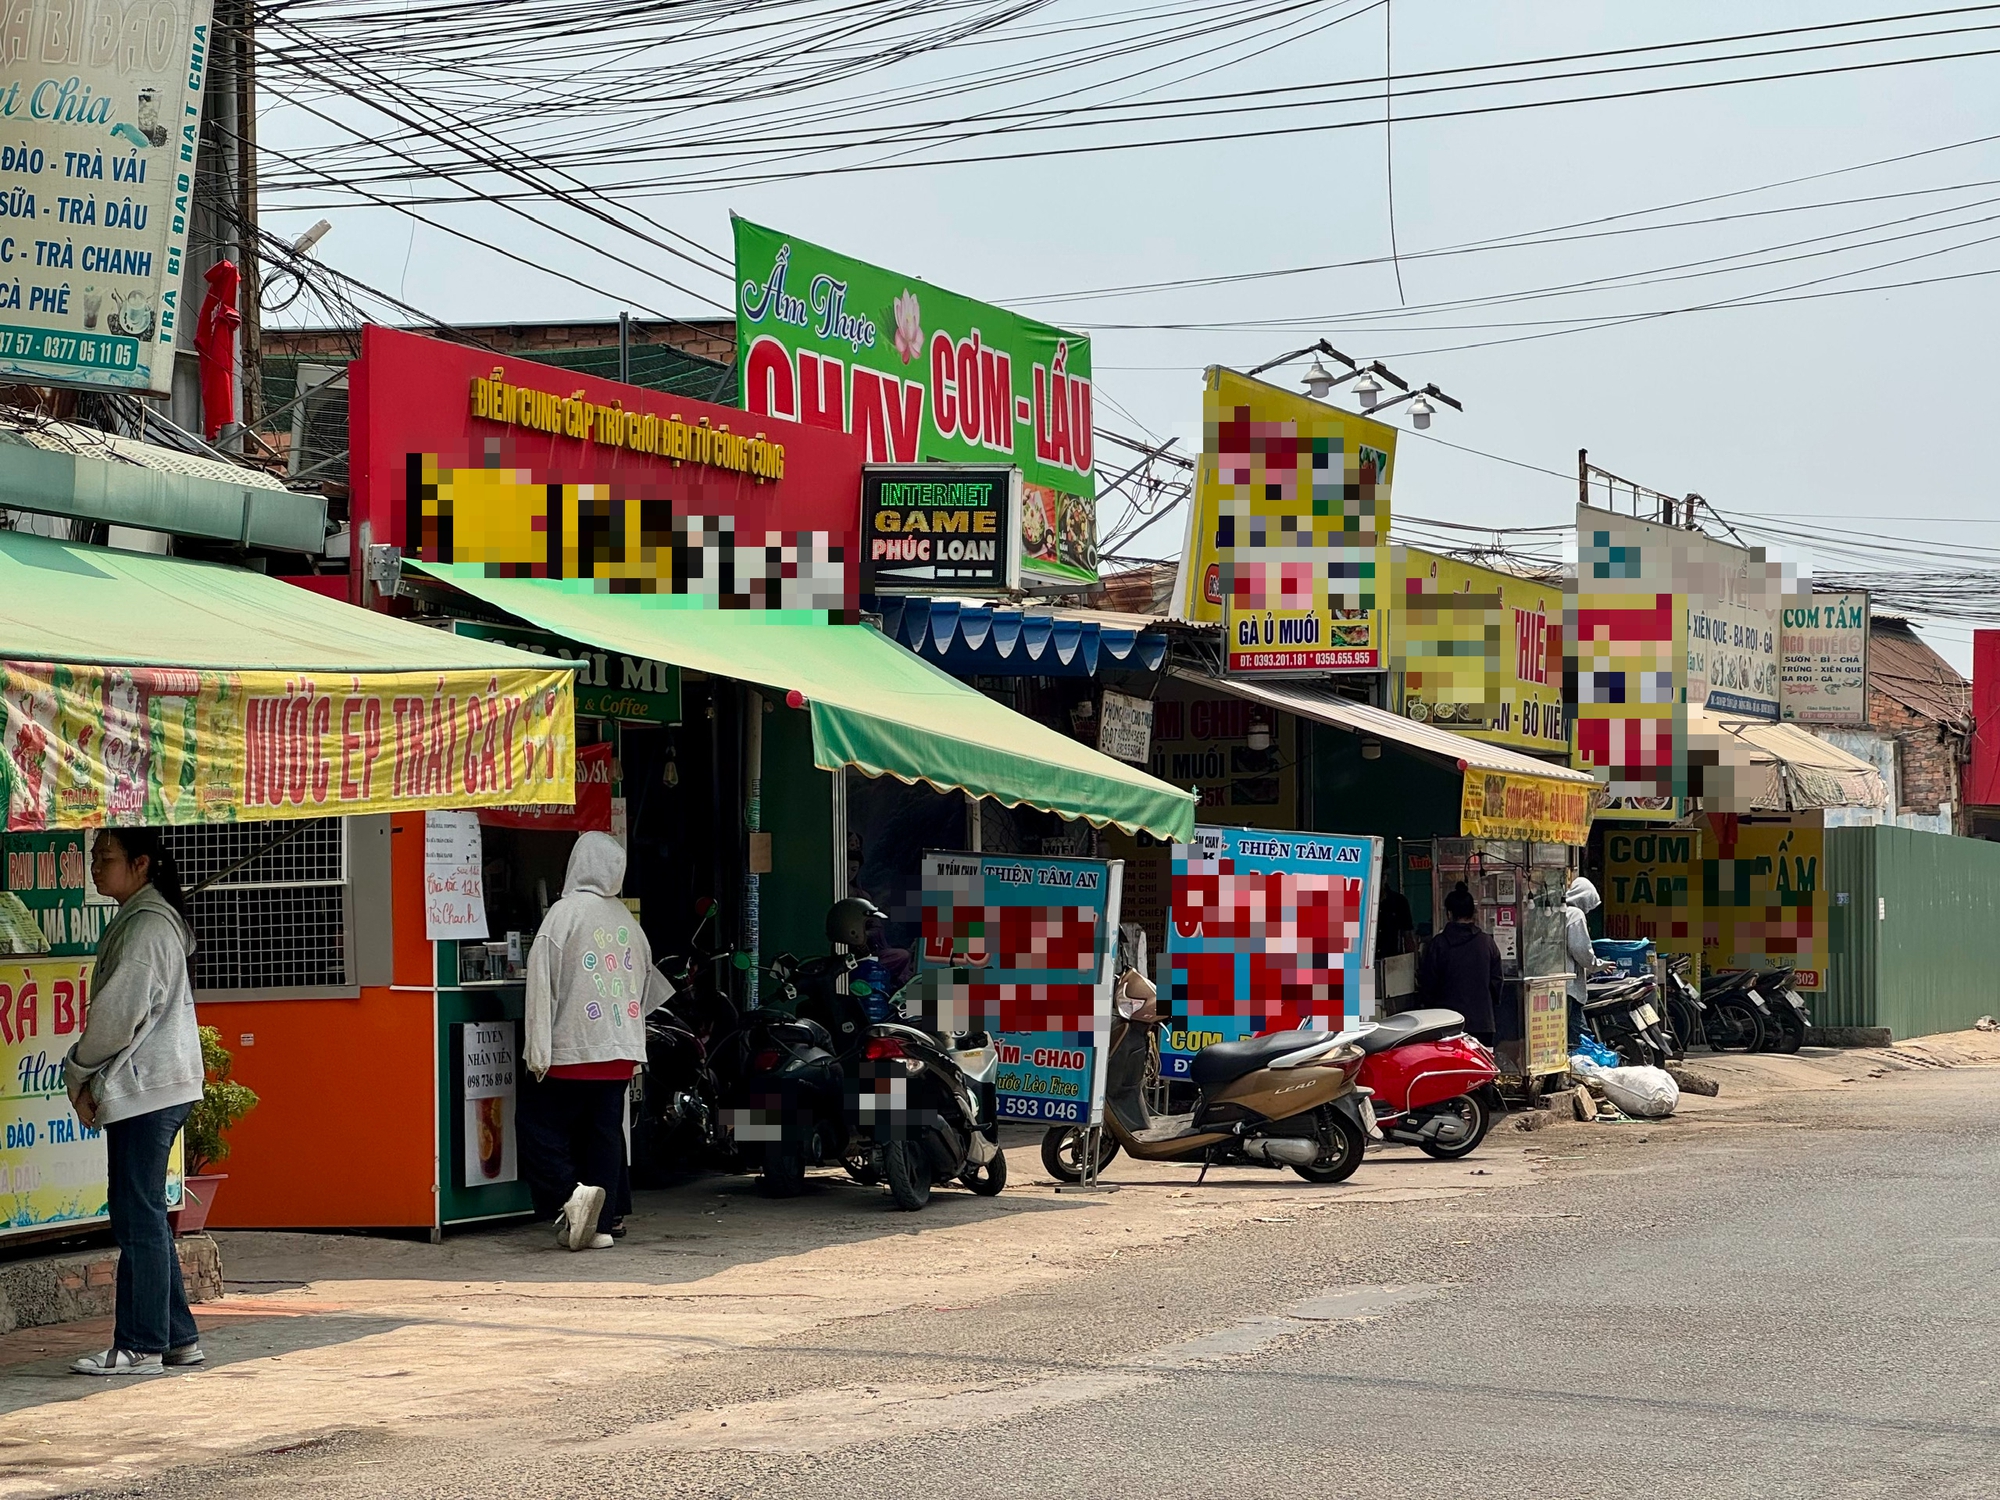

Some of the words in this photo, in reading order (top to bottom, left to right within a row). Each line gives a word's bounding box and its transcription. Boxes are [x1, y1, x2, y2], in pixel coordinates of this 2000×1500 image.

[188, 24, 207, 92] CHIA
[31, 75, 115, 124] Chia
[180, 101, 200, 163] HẠT
[1, 140, 44, 174] ĐÀO
[64, 147, 103, 179] TRÀ
[112, 147, 147, 184] VẢI
[0, 186, 36, 220] SỮA
[57, 193, 96, 226] TRÀ
[104, 196, 148, 230] DÂU
[171, 173, 190, 234] ĐAO
[35, 237, 73, 269] TRÀ
[82, 246, 152, 276] CHANH
[167, 246, 182, 276] BÍ
[29, 283, 71, 315] PHÊ
[743, 244, 807, 322] Ẩm
[810, 273, 876, 352] Thực
[159, 289, 178, 344] TRÀ
[16, 333, 33, 357] 57
[43, 336, 75, 364] 0377
[79, 340, 96, 364] 05
[99, 343, 112, 364] 11
[115, 345, 132, 366] 05
[472, 366, 517, 424] ĐIỂM
[516, 387, 562, 434] CUNG
[561, 389, 594, 440] CẤP
[594, 399, 625, 447] TRÒ
[623, 411, 660, 456] CHƠI
[659, 413, 693, 468] ĐIỆN
[691, 416, 712, 465] TỬ
[711, 424, 748, 472] CÔNG
[747, 432, 785, 485] CỘNG
[880, 483, 993, 507] INTERNET
[874, 510, 997, 533] GAME
[871, 534, 931, 561] PHÚC
[936, 539, 996, 561] LOAN
[1239, 616, 1259, 646] GÀ
[1264, 611, 1274, 645] Ủ
[1279, 610, 1320, 644] MUỐI
[1824, 595, 1863, 629] TẤM
[1693, 610, 1711, 640] XIÊN
[1712, 618, 1727, 646] QUE
[1733, 624, 1744, 648] BA
[1745, 627, 1758, 655] RỌI
[1763, 626, 1773, 654] GÀ
[1240, 656, 1252, 667] ĐT:
[1254, 652, 1307, 667] 0393.201.181
[1315, 651, 1370, 665] 0359.655.955
[1782, 665, 1812, 673] TRỨNG
[1820, 665, 1842, 673] XIÊN
[1844, 666, 1863, 674] QUE
[1784, 655, 1811, 663] SƯỜN
[1820, 654, 1830, 663] BÌ
[1839, 655, 1859, 663] CHẢ
[1796, 675, 1813, 684] RỌI
[1820, 675, 1833, 683] GÀ
[600, 695, 649, 716] Coffee
[1522, 692, 1540, 737] BÒ
[244, 676, 330, 806] NƯỚC
[340, 676, 381, 800] ÉP
[392, 676, 457, 797] TRÁI
[463, 676, 521, 796] CÂY
[1204, 836, 1220, 850] CHAY
[1237, 838, 1291, 862] THIỆN
[1295, 842, 1332, 861] TÂM
[1336, 847, 1361, 864] AN
[1609, 834, 1689, 864] CƠM
[8, 852, 34, 890] RAU
[37, 841, 57, 890] MÁ
[59, 841, 84, 890] SỮA
[1038, 865, 1072, 886] TÂM
[1075, 872, 1099, 889] AN
[43, 898, 67, 944] MÁ
[442, 902, 480, 925] Chanh
[467, 1049, 491, 1066] NHÂN
[492, 1047, 512, 1064] VIÊN
[1034, 1048, 1085, 1070] CHAO
[467, 1074, 480, 1088] 098
[481, 1073, 494, 1087] 736
[495, 1072, 503, 1086] 89
[504, 1071, 513, 1085] 68
[996, 1072, 1020, 1091] ước
[1022, 1074, 1047, 1093] Lèo
[1049, 1076, 1079, 1096] Free
[1005, 1097, 1039, 1117] 593
[1044, 1101, 1077, 1120] 046
[7, 1117, 35, 1149] ĐÀO
[47, 1111, 75, 1144] TRÀ
